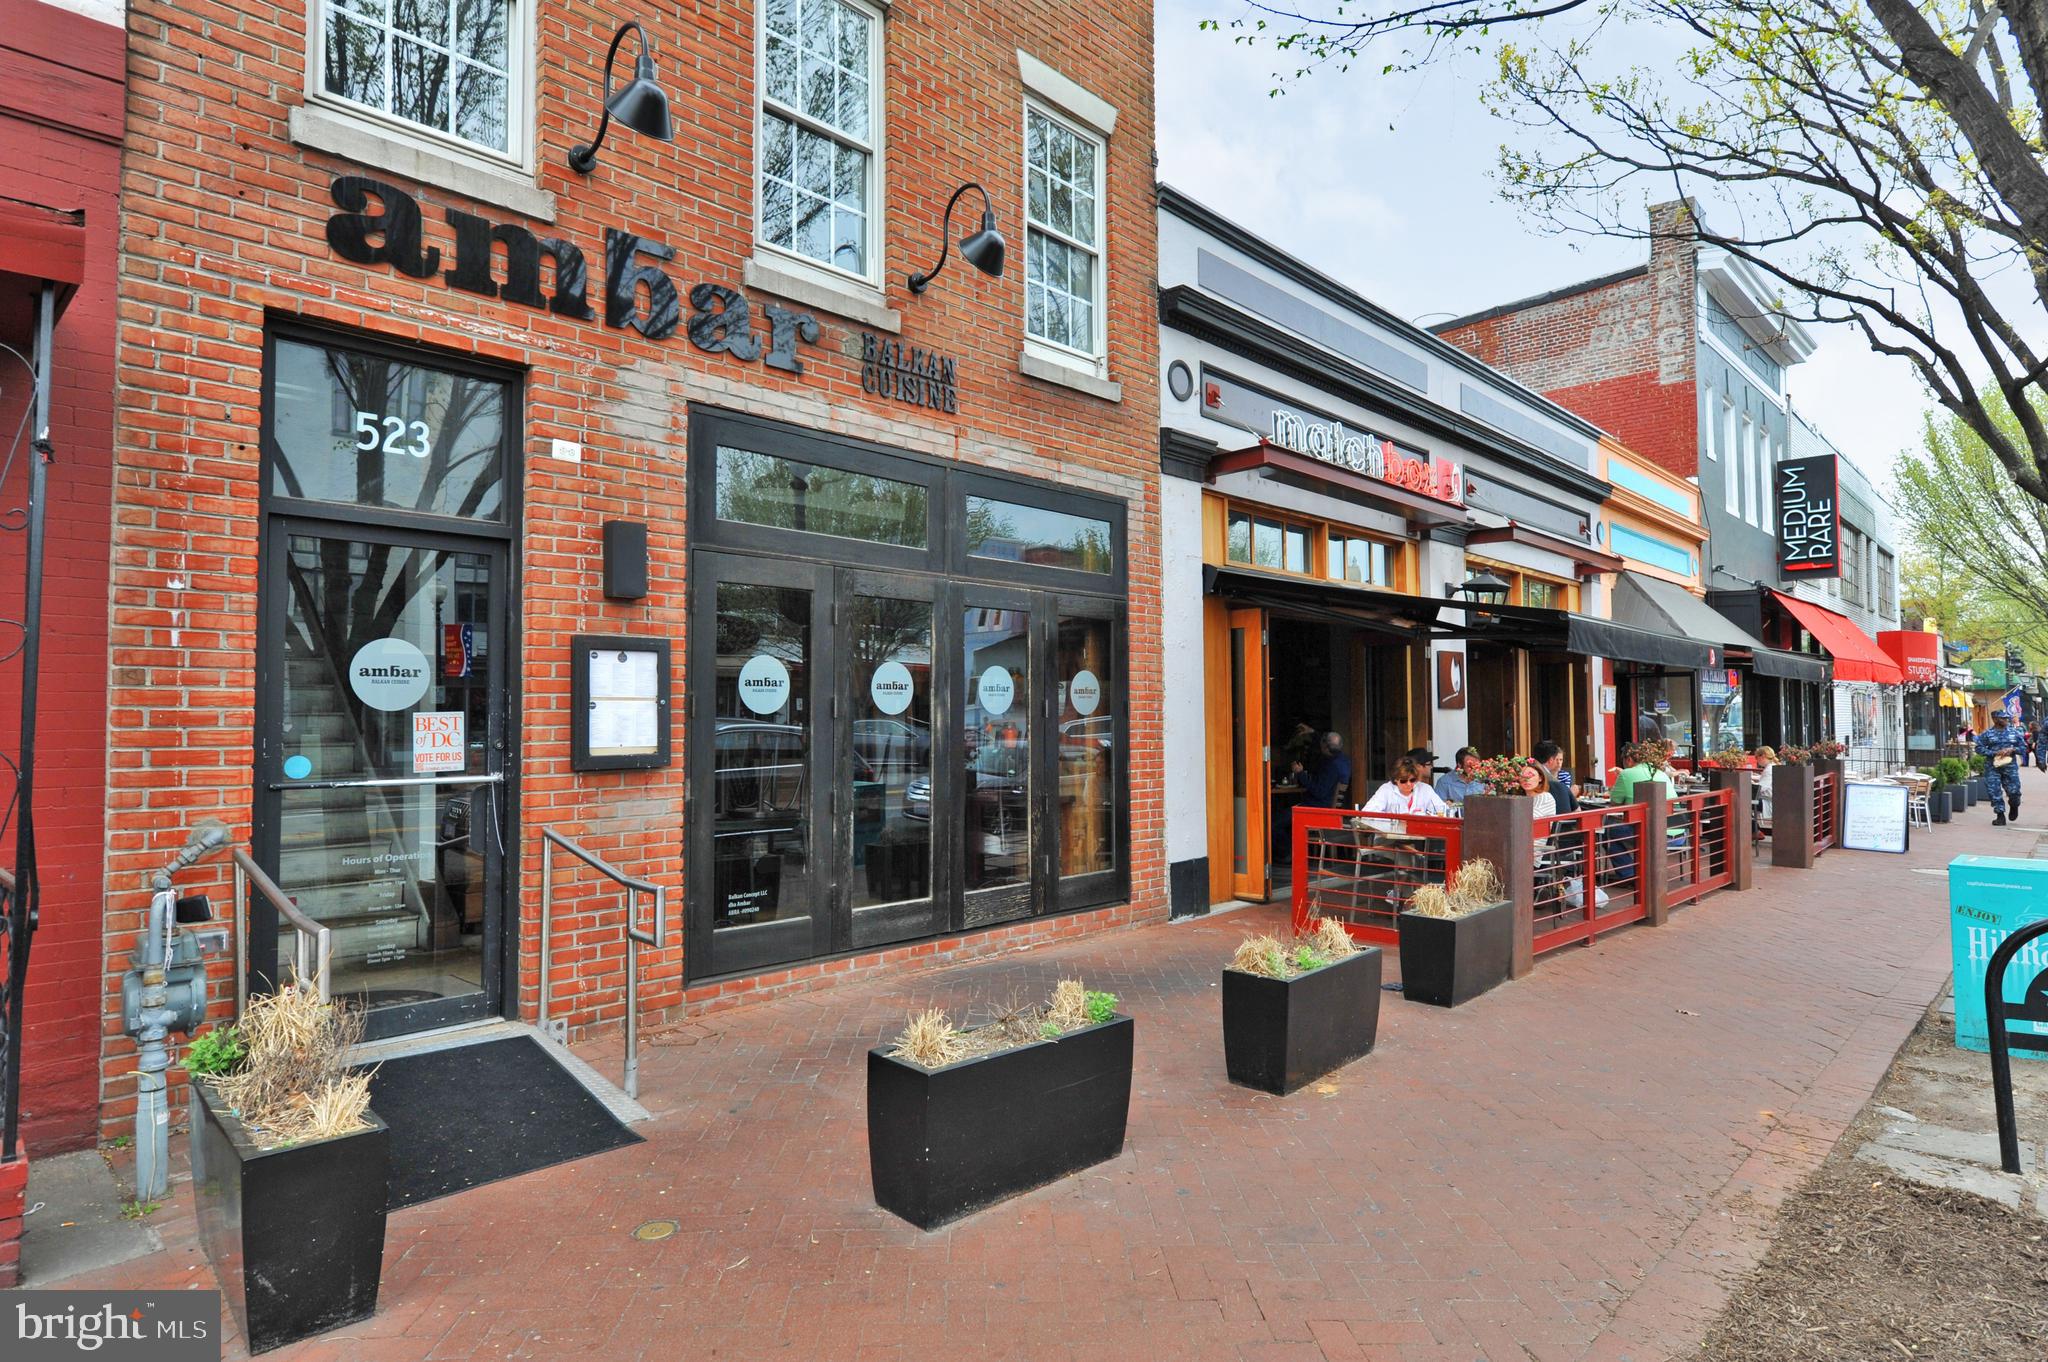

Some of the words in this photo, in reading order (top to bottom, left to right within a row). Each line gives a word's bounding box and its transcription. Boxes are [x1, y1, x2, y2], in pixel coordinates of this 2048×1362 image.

[862, 332, 958, 386] BALKAN
[862, 363, 958, 415] CUISINE
[355, 411, 431, 458] 523
[1272, 410, 1438, 496] matchbox
[1782, 467, 1808, 560] MEDIUM
[1807, 498, 1832, 558] RARE
[415, 716, 462, 732] BEST
[415, 732, 427, 748] of
[415, 753, 433, 763] VOTE
[435, 752, 451, 762] FOR
[452, 751, 463, 761] US
[342, 857, 372, 866] Hours
[372, 854, 384, 864] of
[1957, 905, 1999, 924] ENJOY
